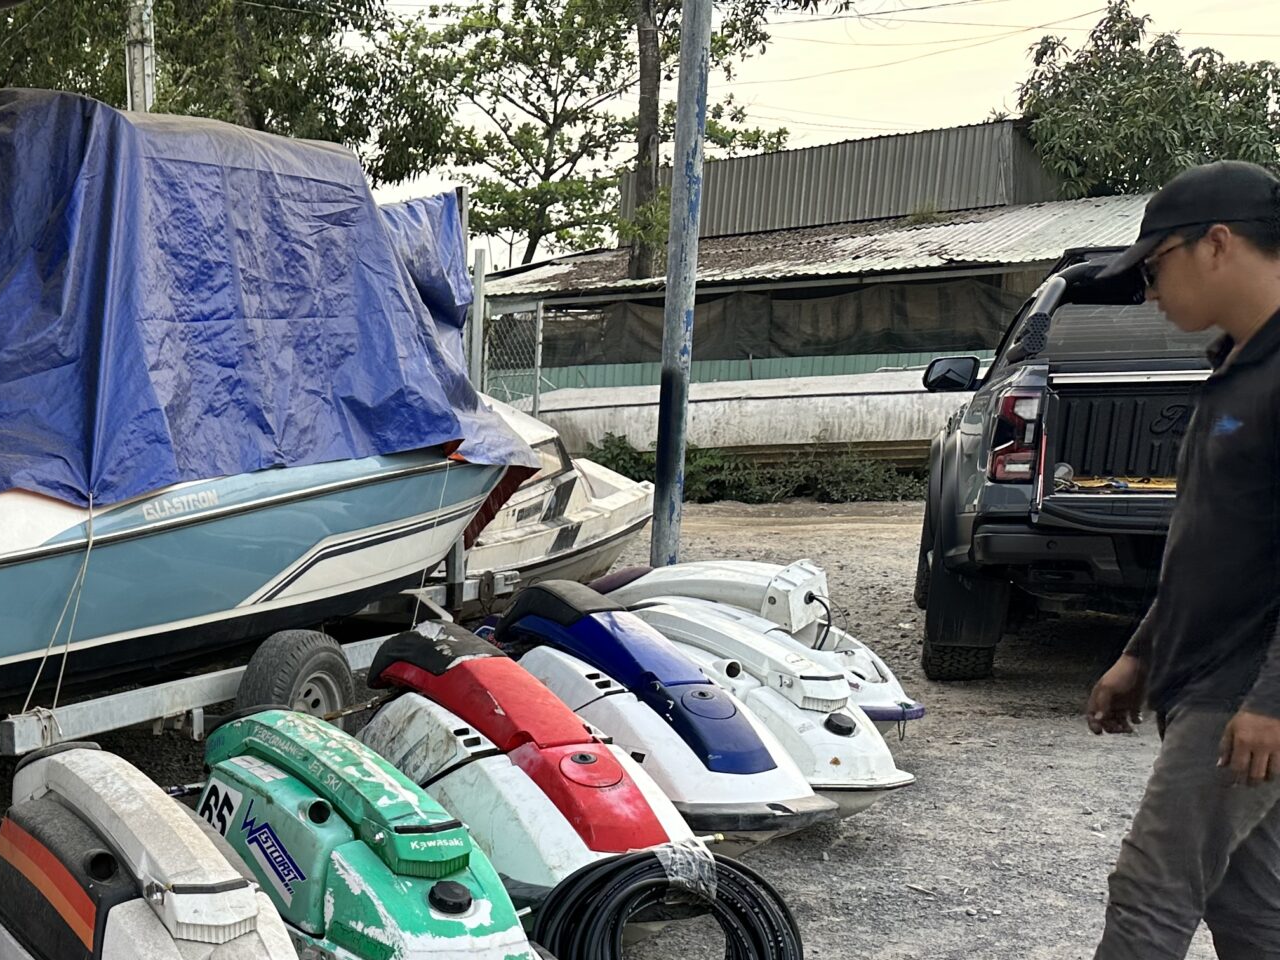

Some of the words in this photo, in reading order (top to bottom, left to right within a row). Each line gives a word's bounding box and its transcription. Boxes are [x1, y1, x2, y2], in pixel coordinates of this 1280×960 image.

[324, 773, 343, 792] SKI
[199, 783, 234, 837] 65
[410, 837, 464, 851] Kawasaki
